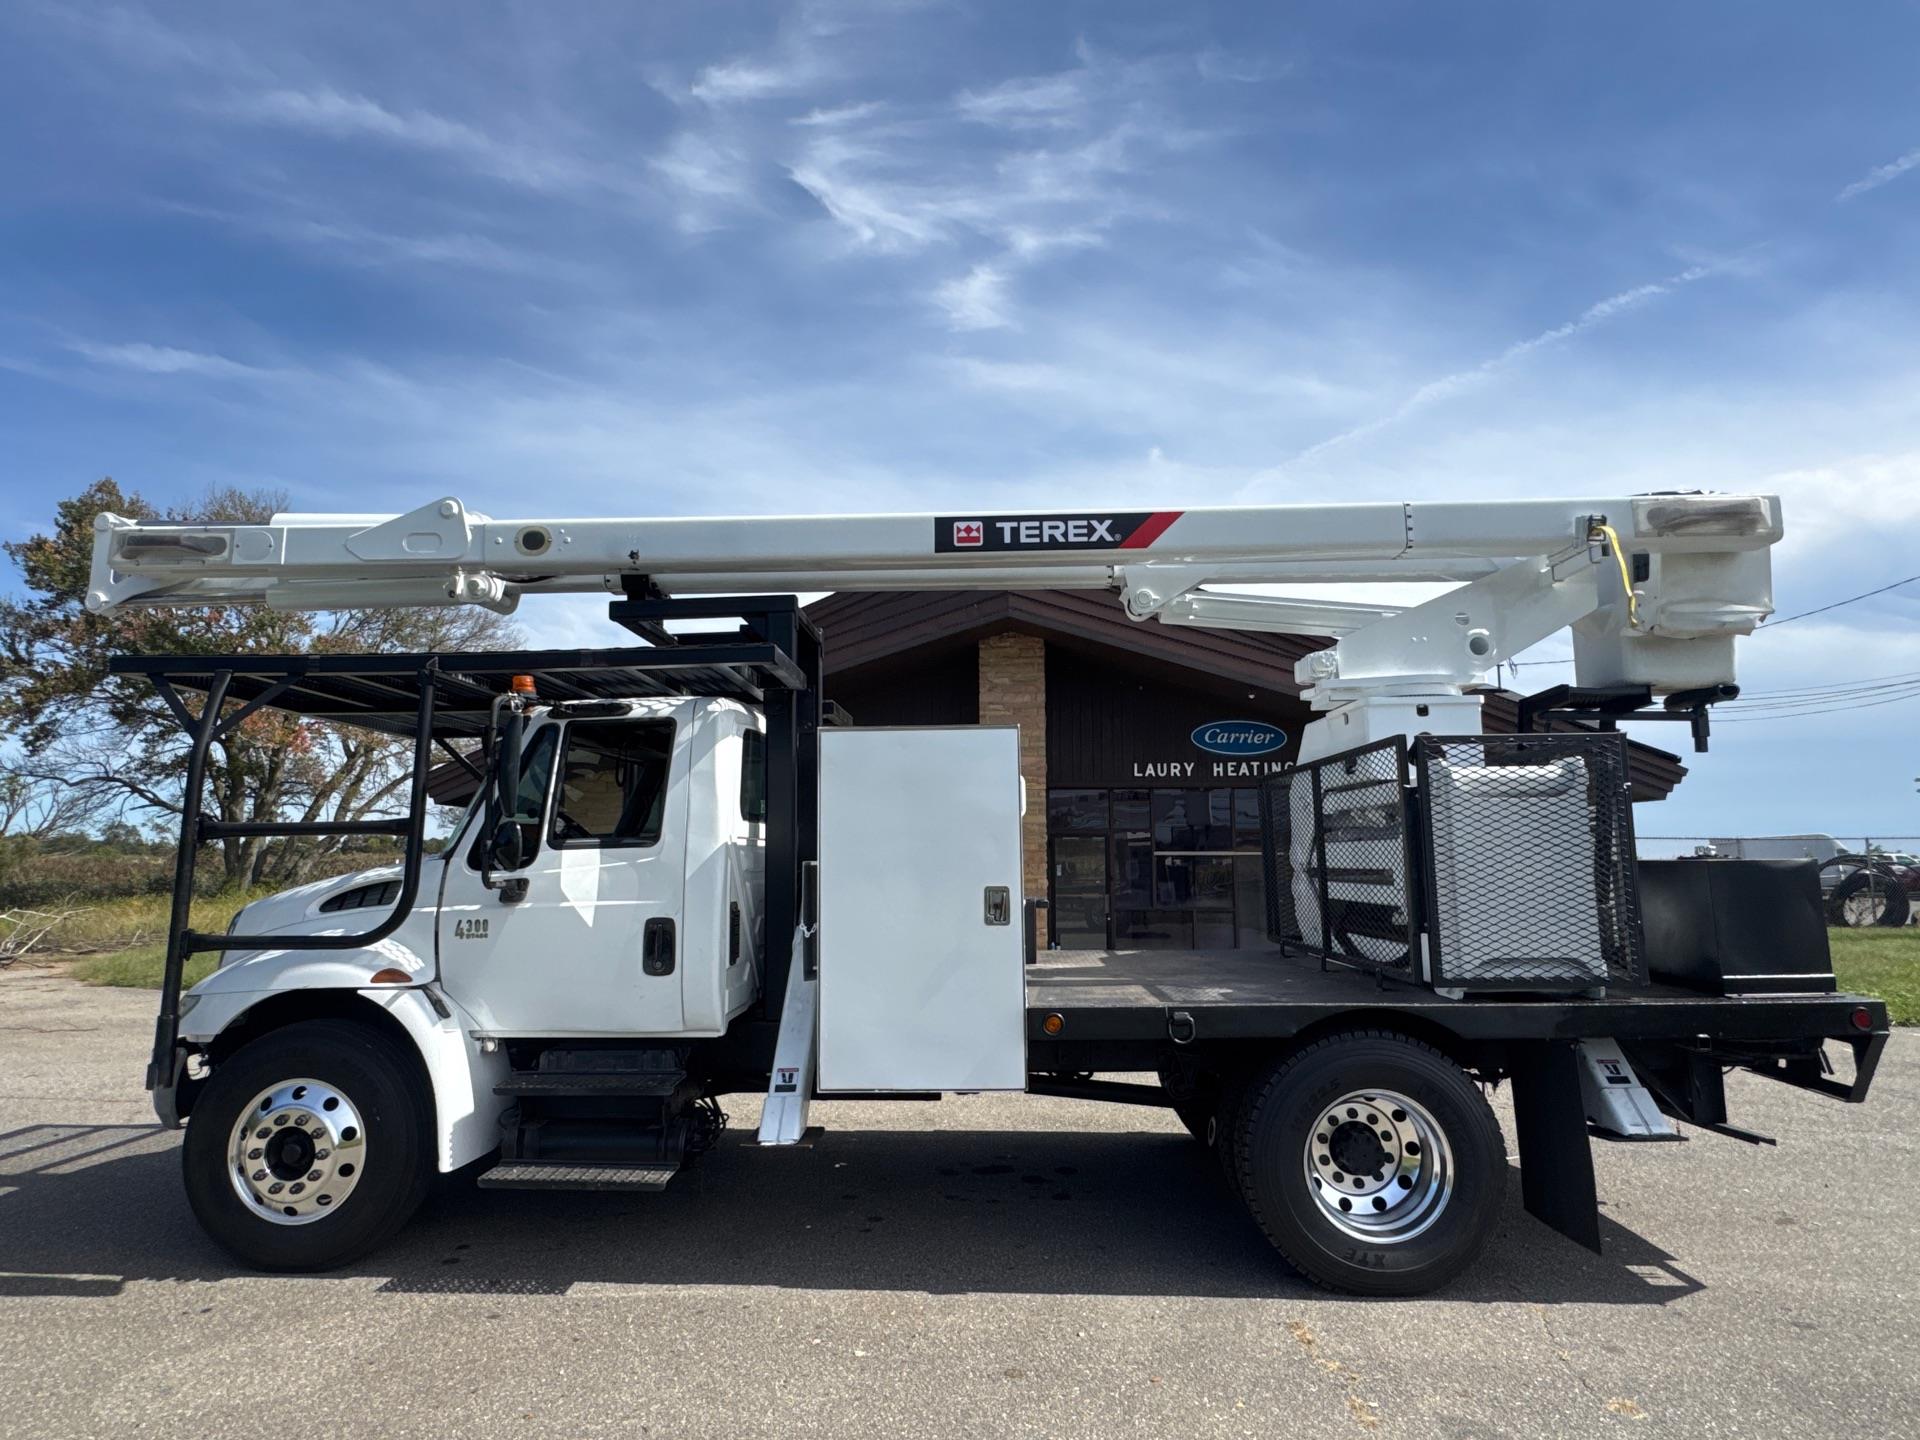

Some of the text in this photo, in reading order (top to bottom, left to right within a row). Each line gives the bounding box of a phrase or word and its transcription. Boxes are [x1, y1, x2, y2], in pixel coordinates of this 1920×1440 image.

[996, 520, 1114, 543] TEREX
[1204, 728, 1274, 744] Carrier
[1133, 762, 1195, 777] LAURY
[455, 918, 489, 939] 4300
